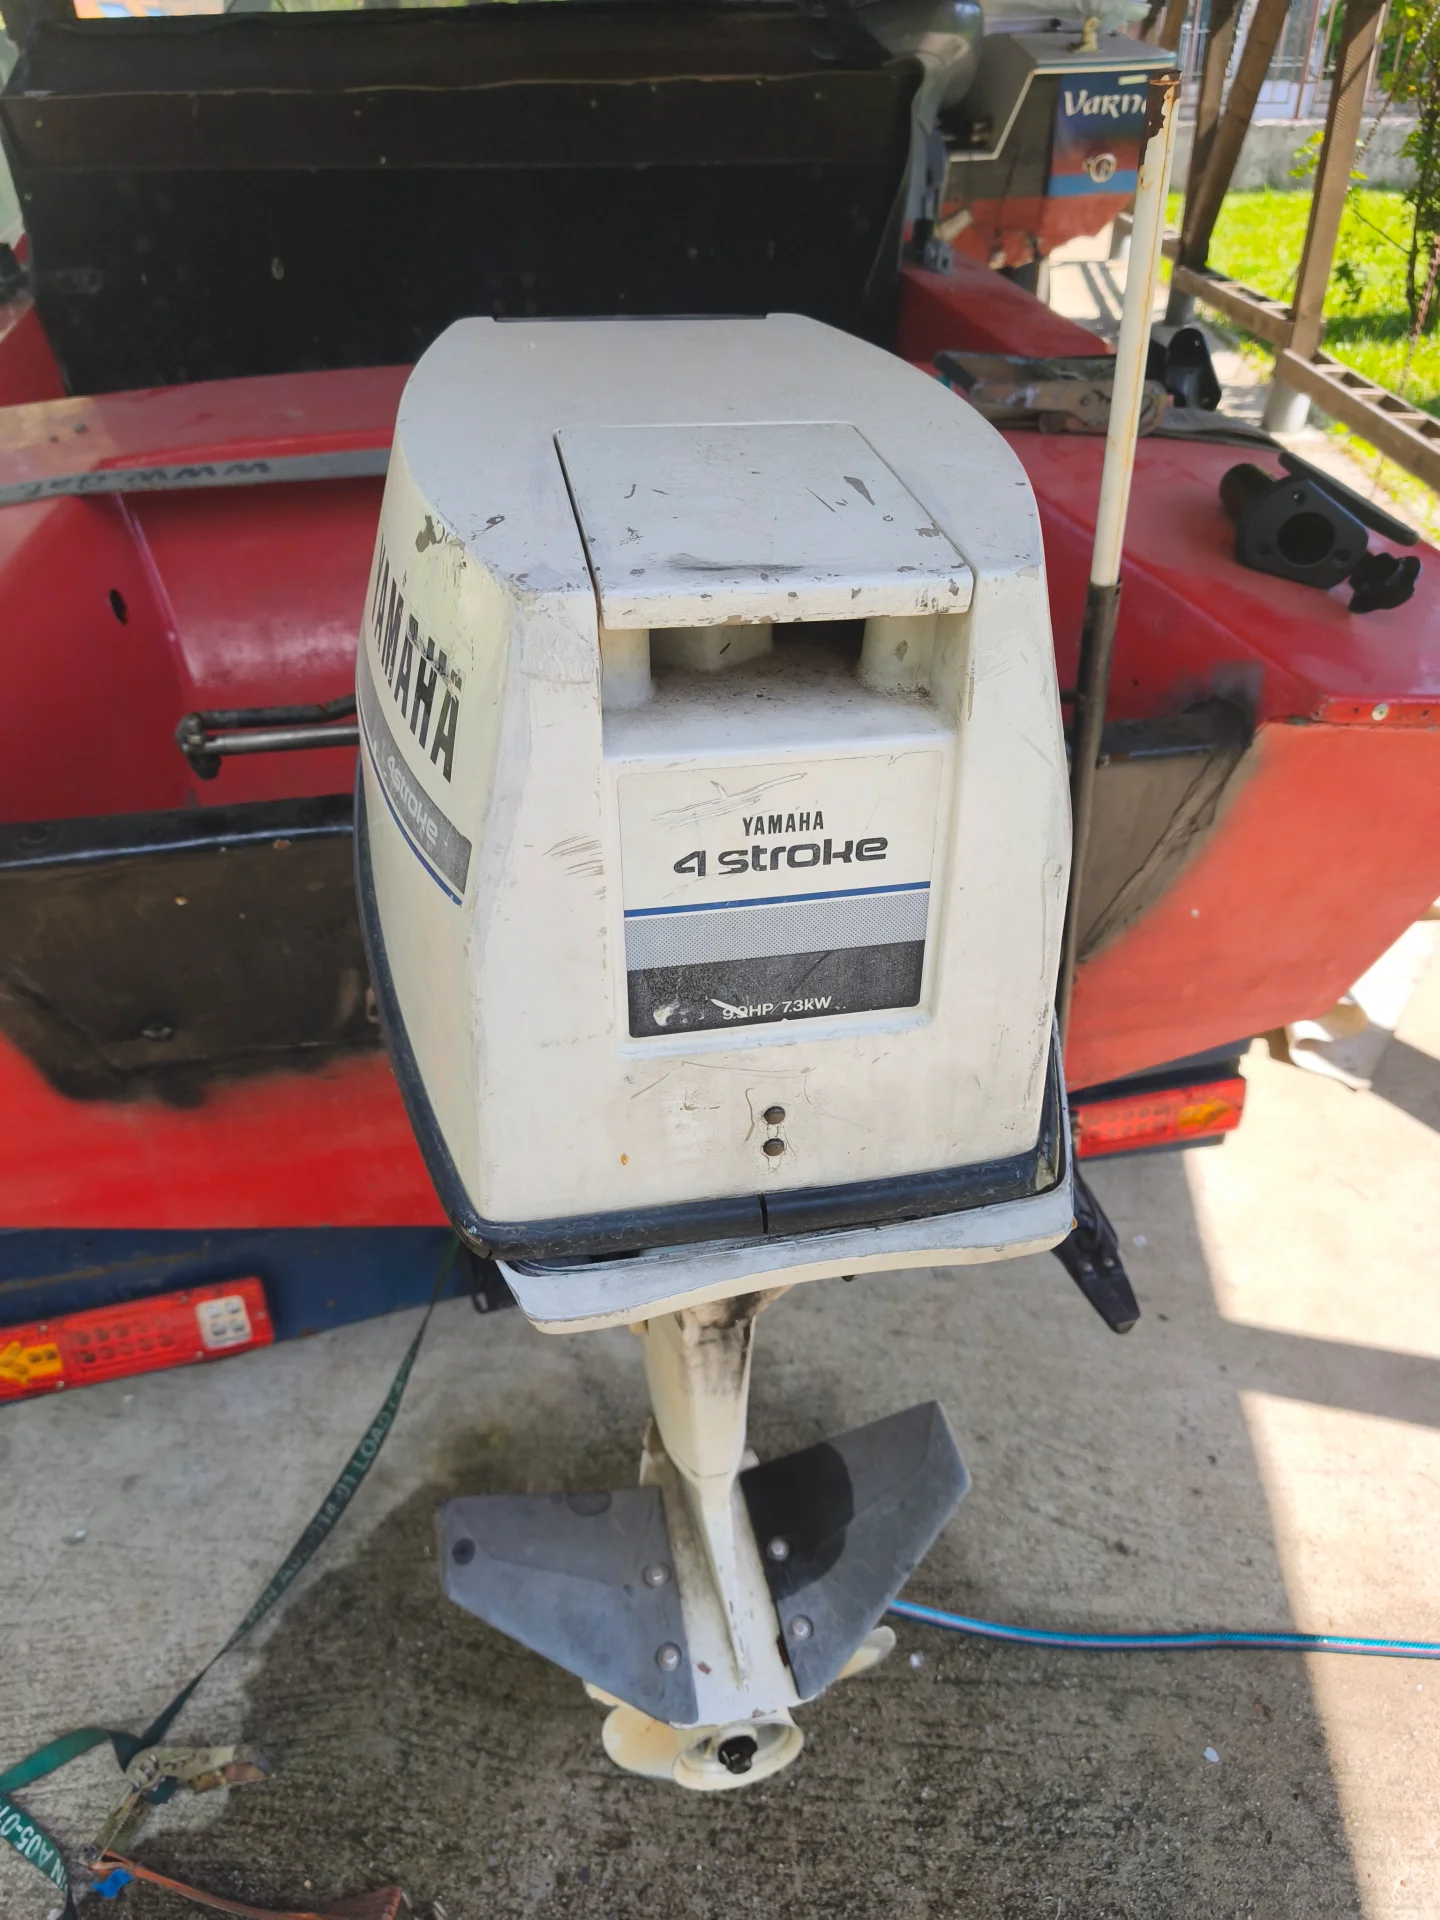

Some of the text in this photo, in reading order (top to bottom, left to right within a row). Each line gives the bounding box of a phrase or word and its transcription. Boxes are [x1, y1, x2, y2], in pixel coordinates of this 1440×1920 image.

[371, 533, 462, 785] YAMAHA
[742, 810, 824, 837] YAMAHA
[717, 836, 889, 876] stroke
[0, 1798, 55, 1868] A05-01
